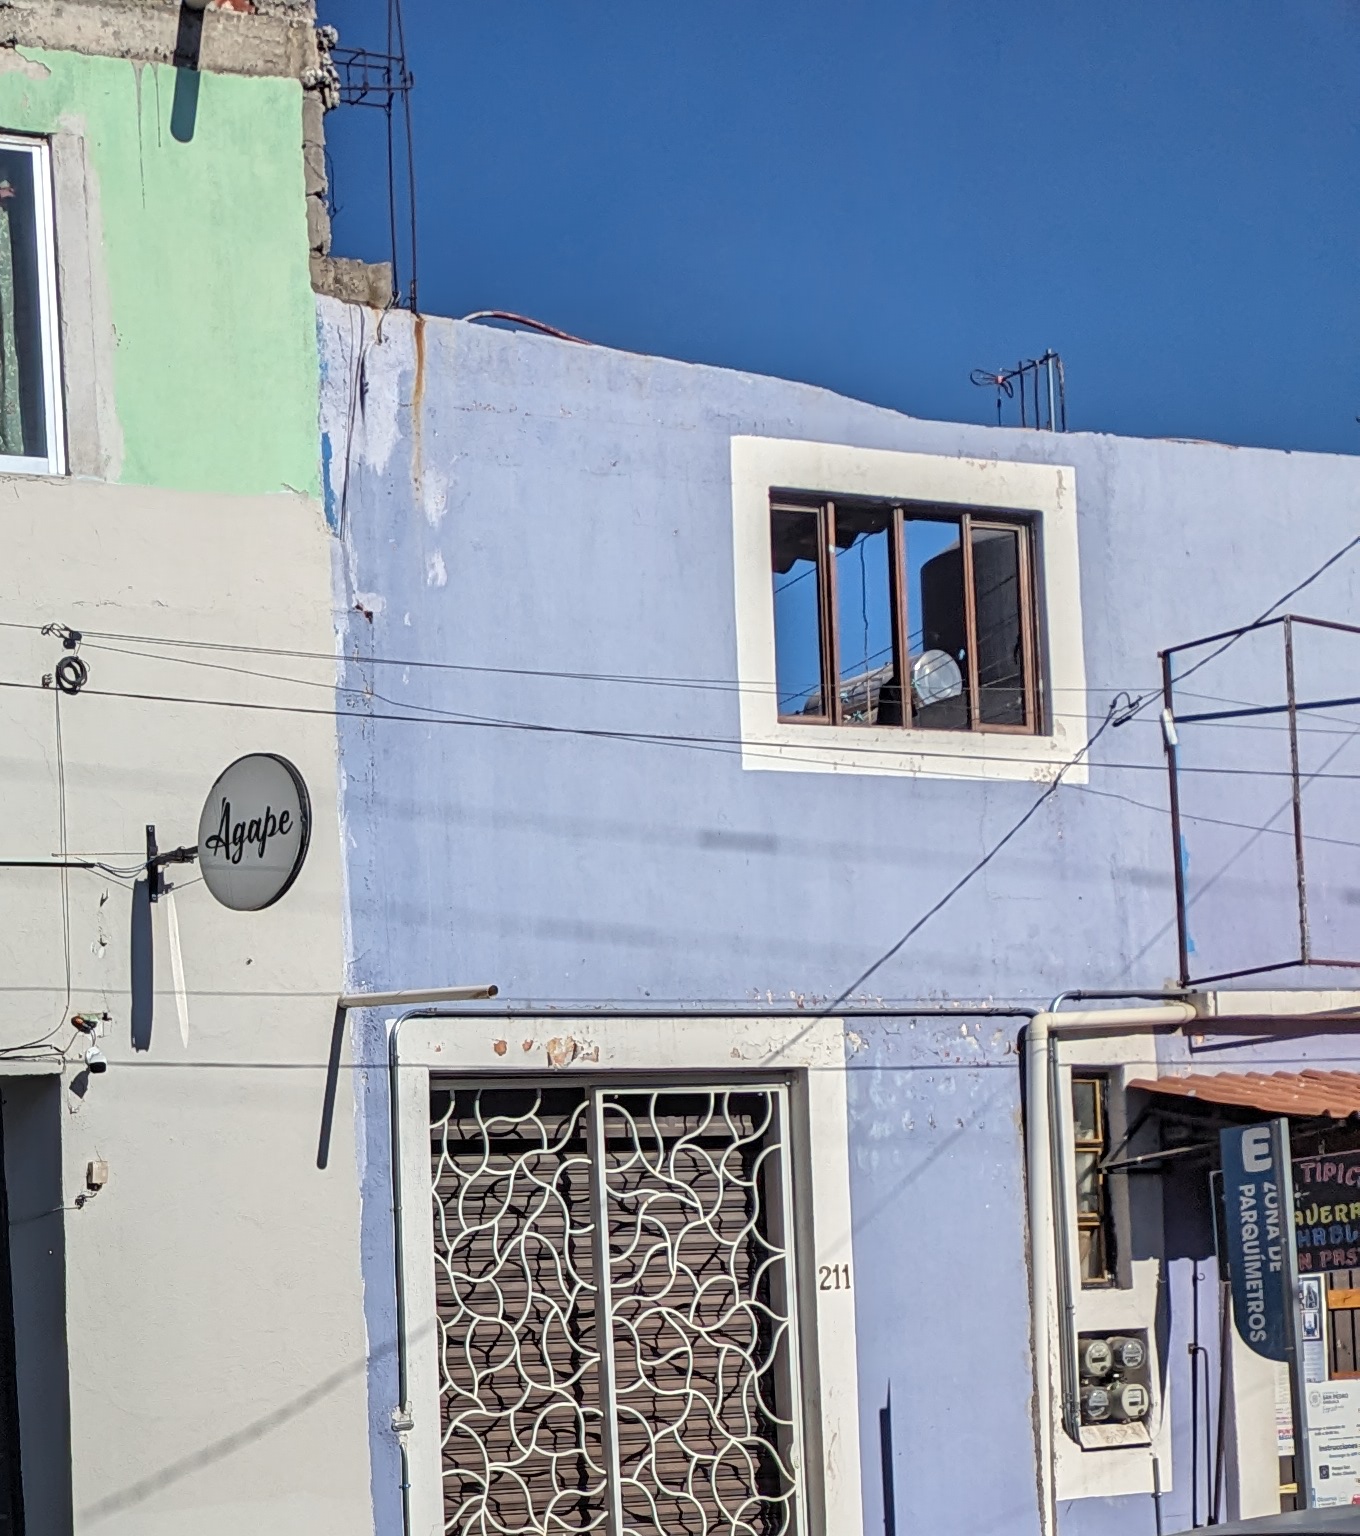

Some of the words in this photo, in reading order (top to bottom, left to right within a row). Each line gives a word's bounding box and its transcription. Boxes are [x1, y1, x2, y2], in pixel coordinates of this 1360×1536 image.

[1241, 1127, 1273, 1173] E
[819, 1263, 851, 1291] 211
[1238, 1183, 1267, 1343] PARQUÍMETROS
